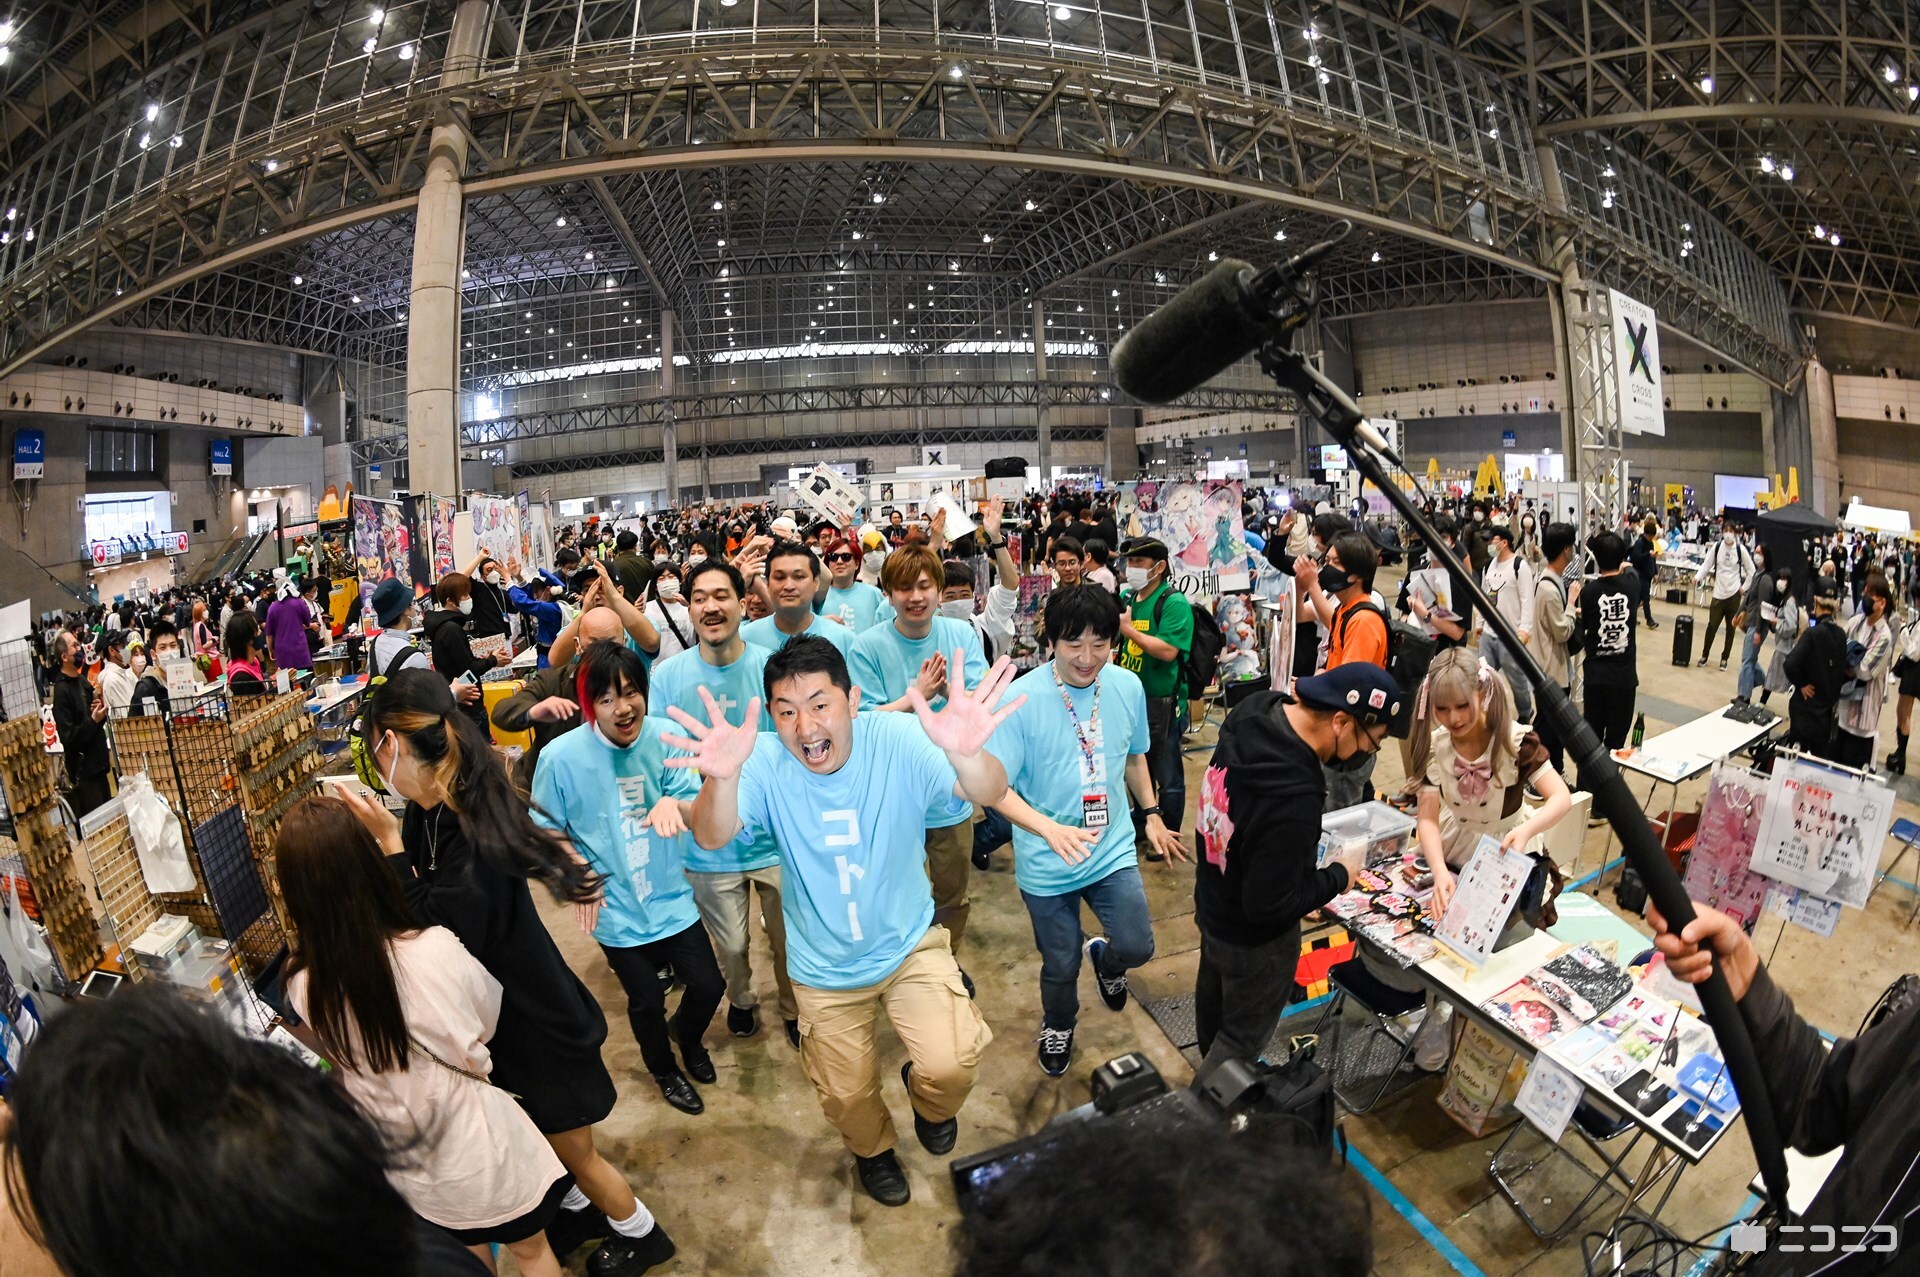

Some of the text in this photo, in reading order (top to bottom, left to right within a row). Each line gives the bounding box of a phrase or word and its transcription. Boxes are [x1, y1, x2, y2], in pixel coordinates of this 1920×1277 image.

[1619, 299, 1647, 319] CREATOR
[1631, 384, 1652, 398] CROSS
[18, 438, 41, 454] HALL 2
[224, 446, 230, 458] 2
[106, 544, 120, 555] 9-11
[1602, 597, 1626, 645] 運営
[1793, 818, 1853, 845] 外しています
[821, 808, 865, 941] コトー
